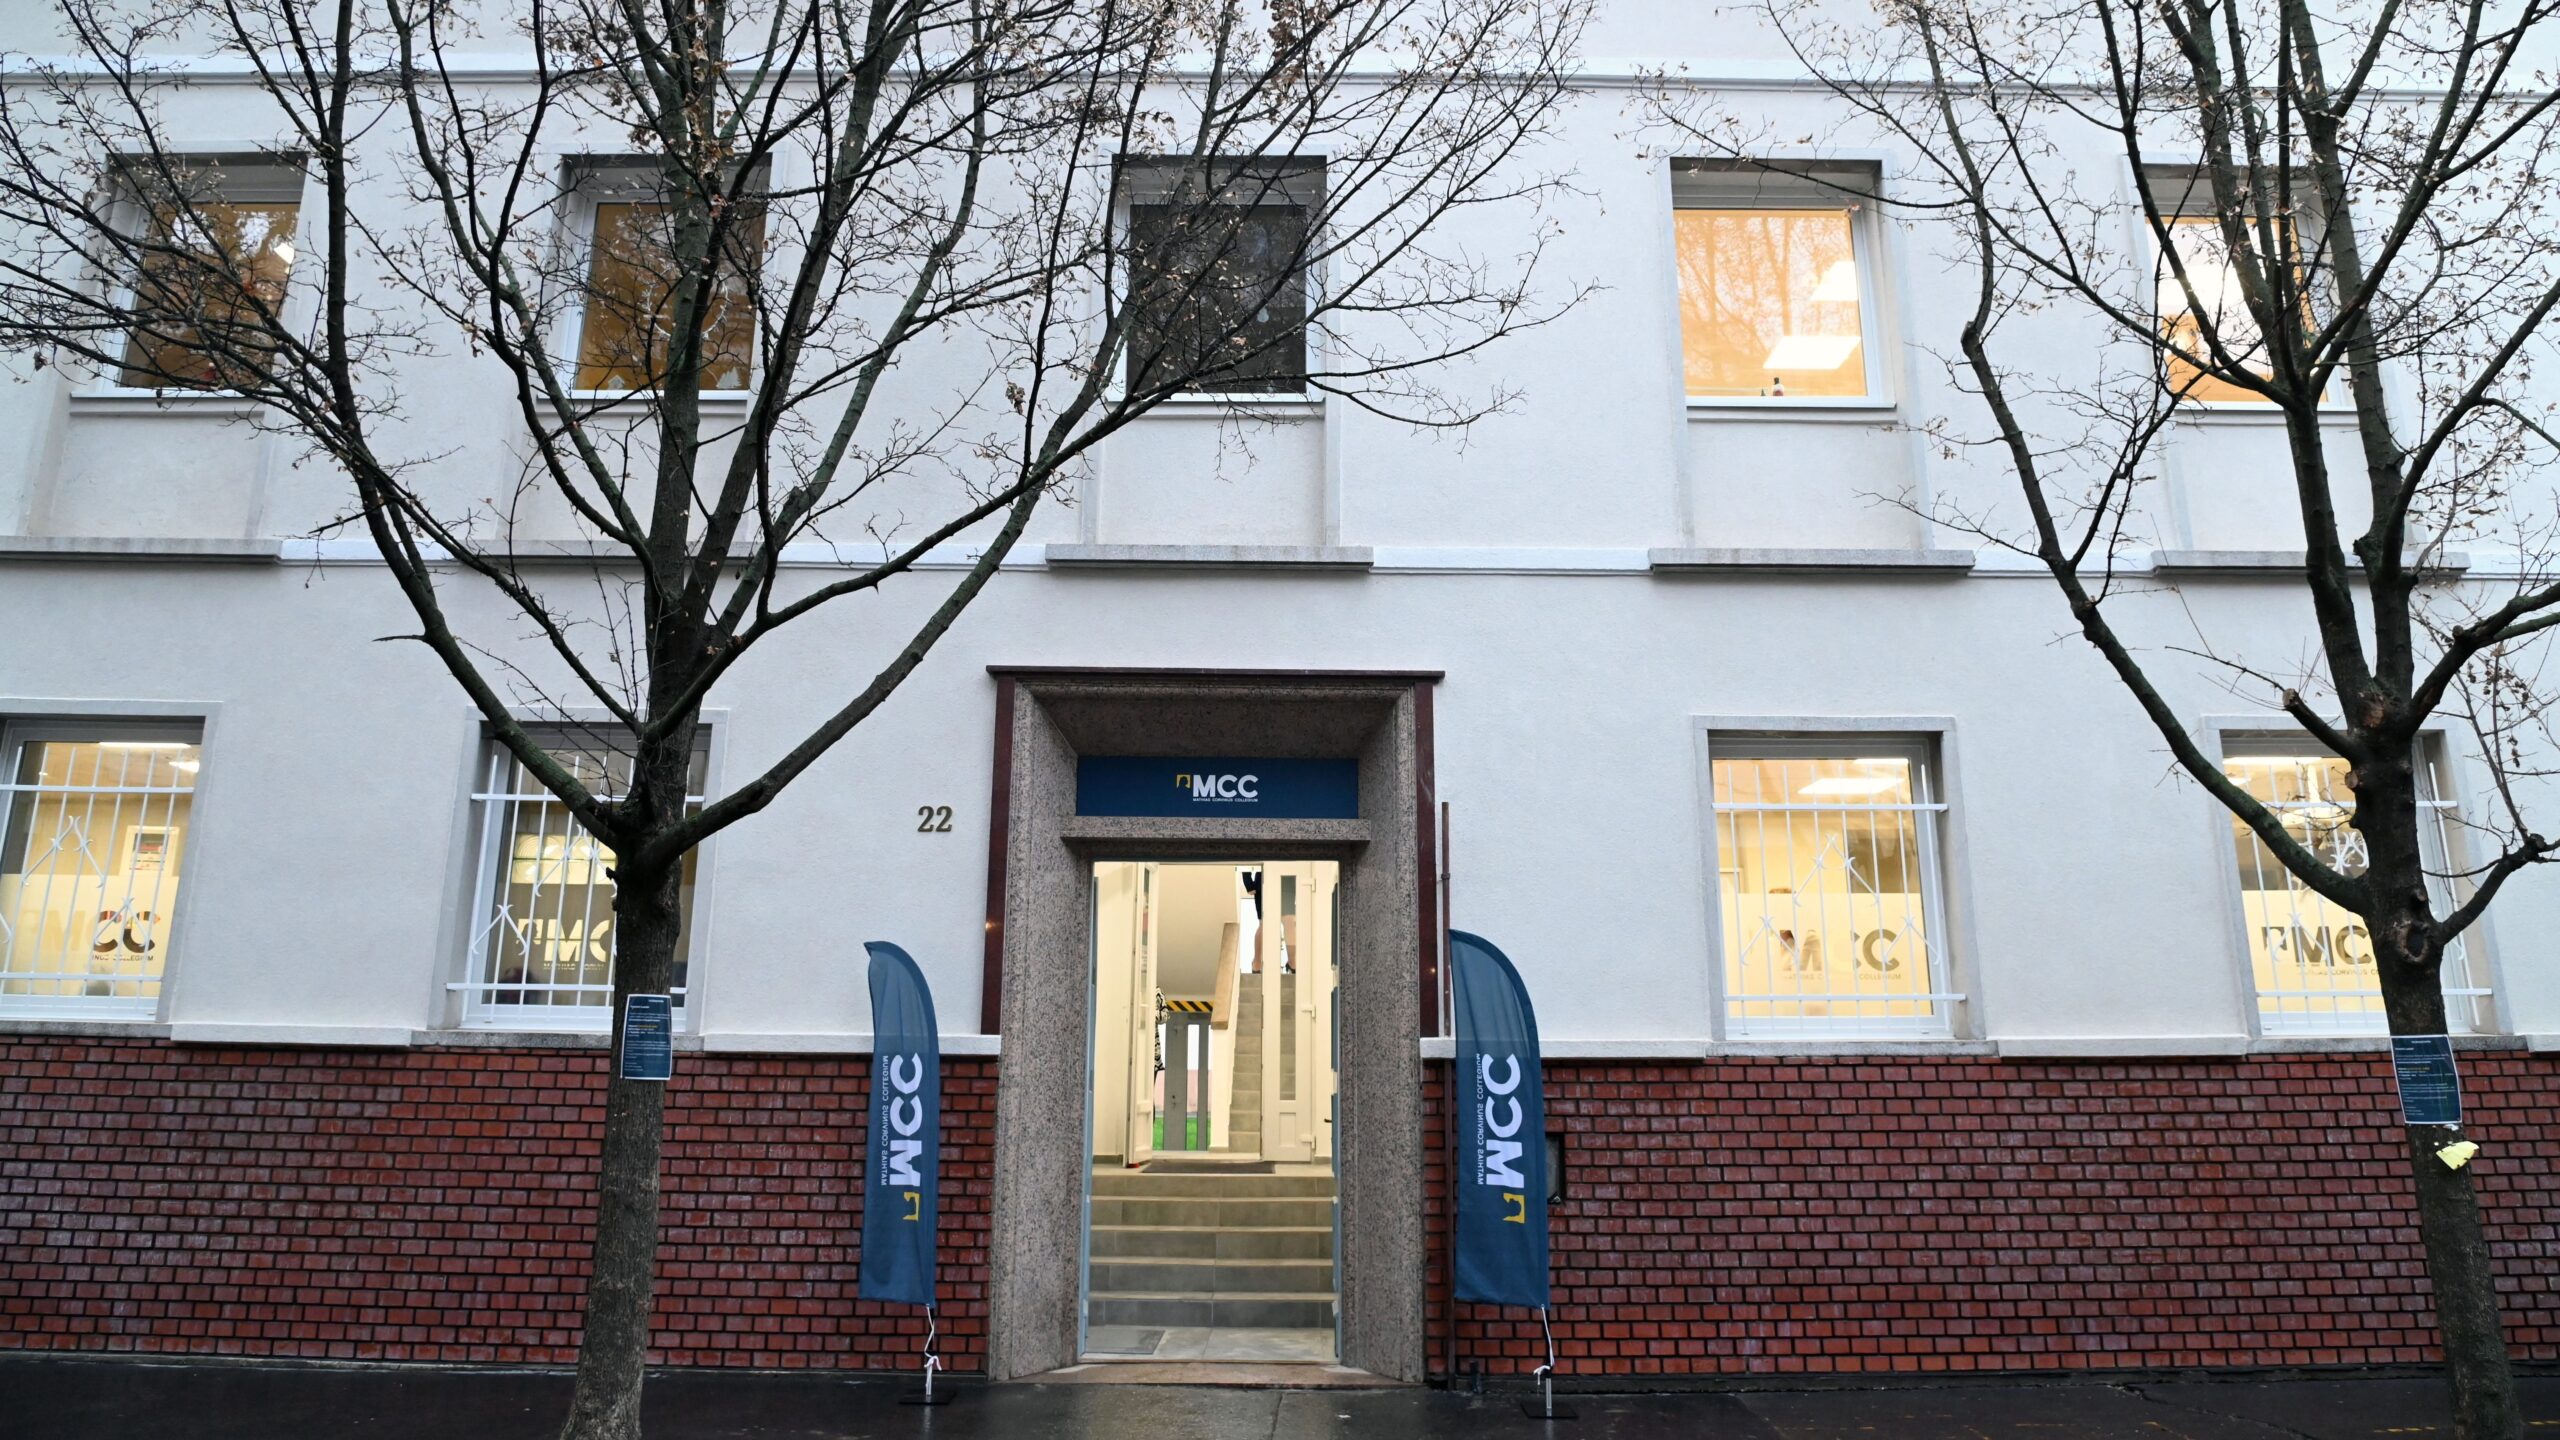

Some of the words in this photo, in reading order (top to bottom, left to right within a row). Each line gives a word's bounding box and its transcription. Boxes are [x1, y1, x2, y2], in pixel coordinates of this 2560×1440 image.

[1193, 774, 1259, 798] MCC
[917, 805, 953, 833] 22
[544, 919, 610, 962] MC
[2291, 925, 2373, 967] MC
